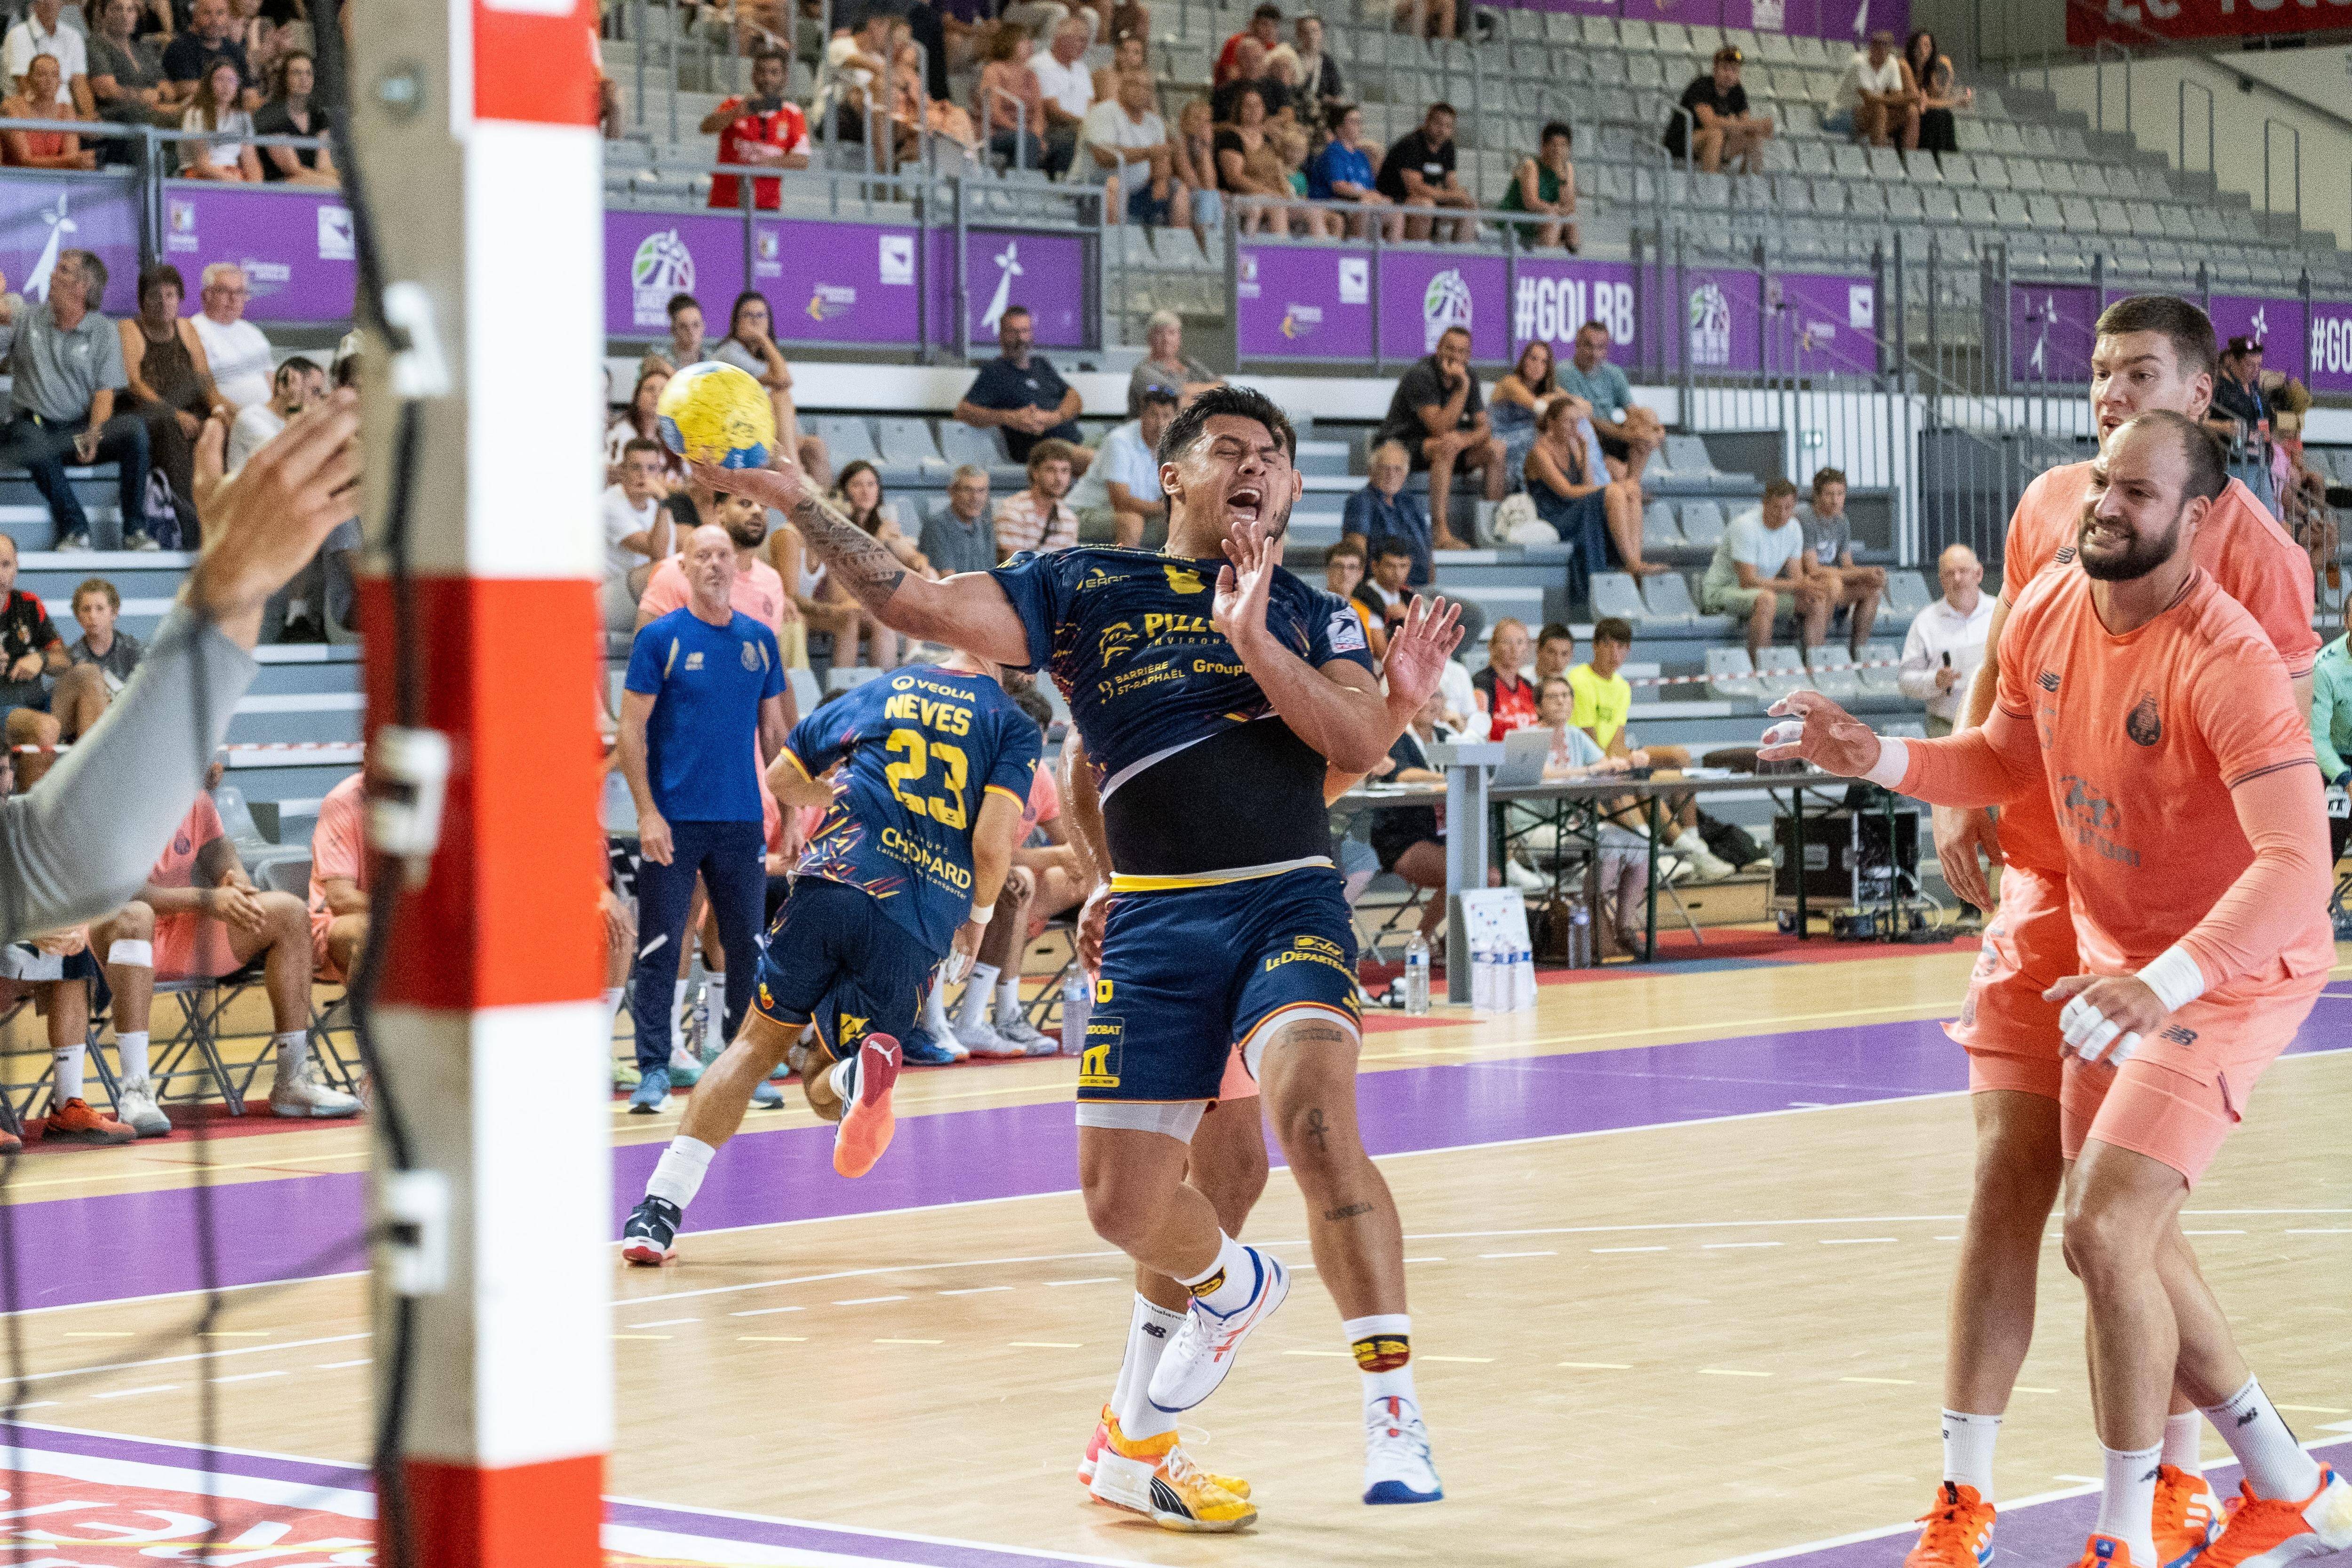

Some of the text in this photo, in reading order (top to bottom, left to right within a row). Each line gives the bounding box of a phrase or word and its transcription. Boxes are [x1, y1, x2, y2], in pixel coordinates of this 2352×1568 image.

[917, 679, 976, 703] VEOLIA
[1117, 669, 1186, 695] ST-RAPHAËL
[884, 693, 973, 737] NEVES
[884, 728, 969, 830] 23
[881, 827, 971, 889] CHOPARD
